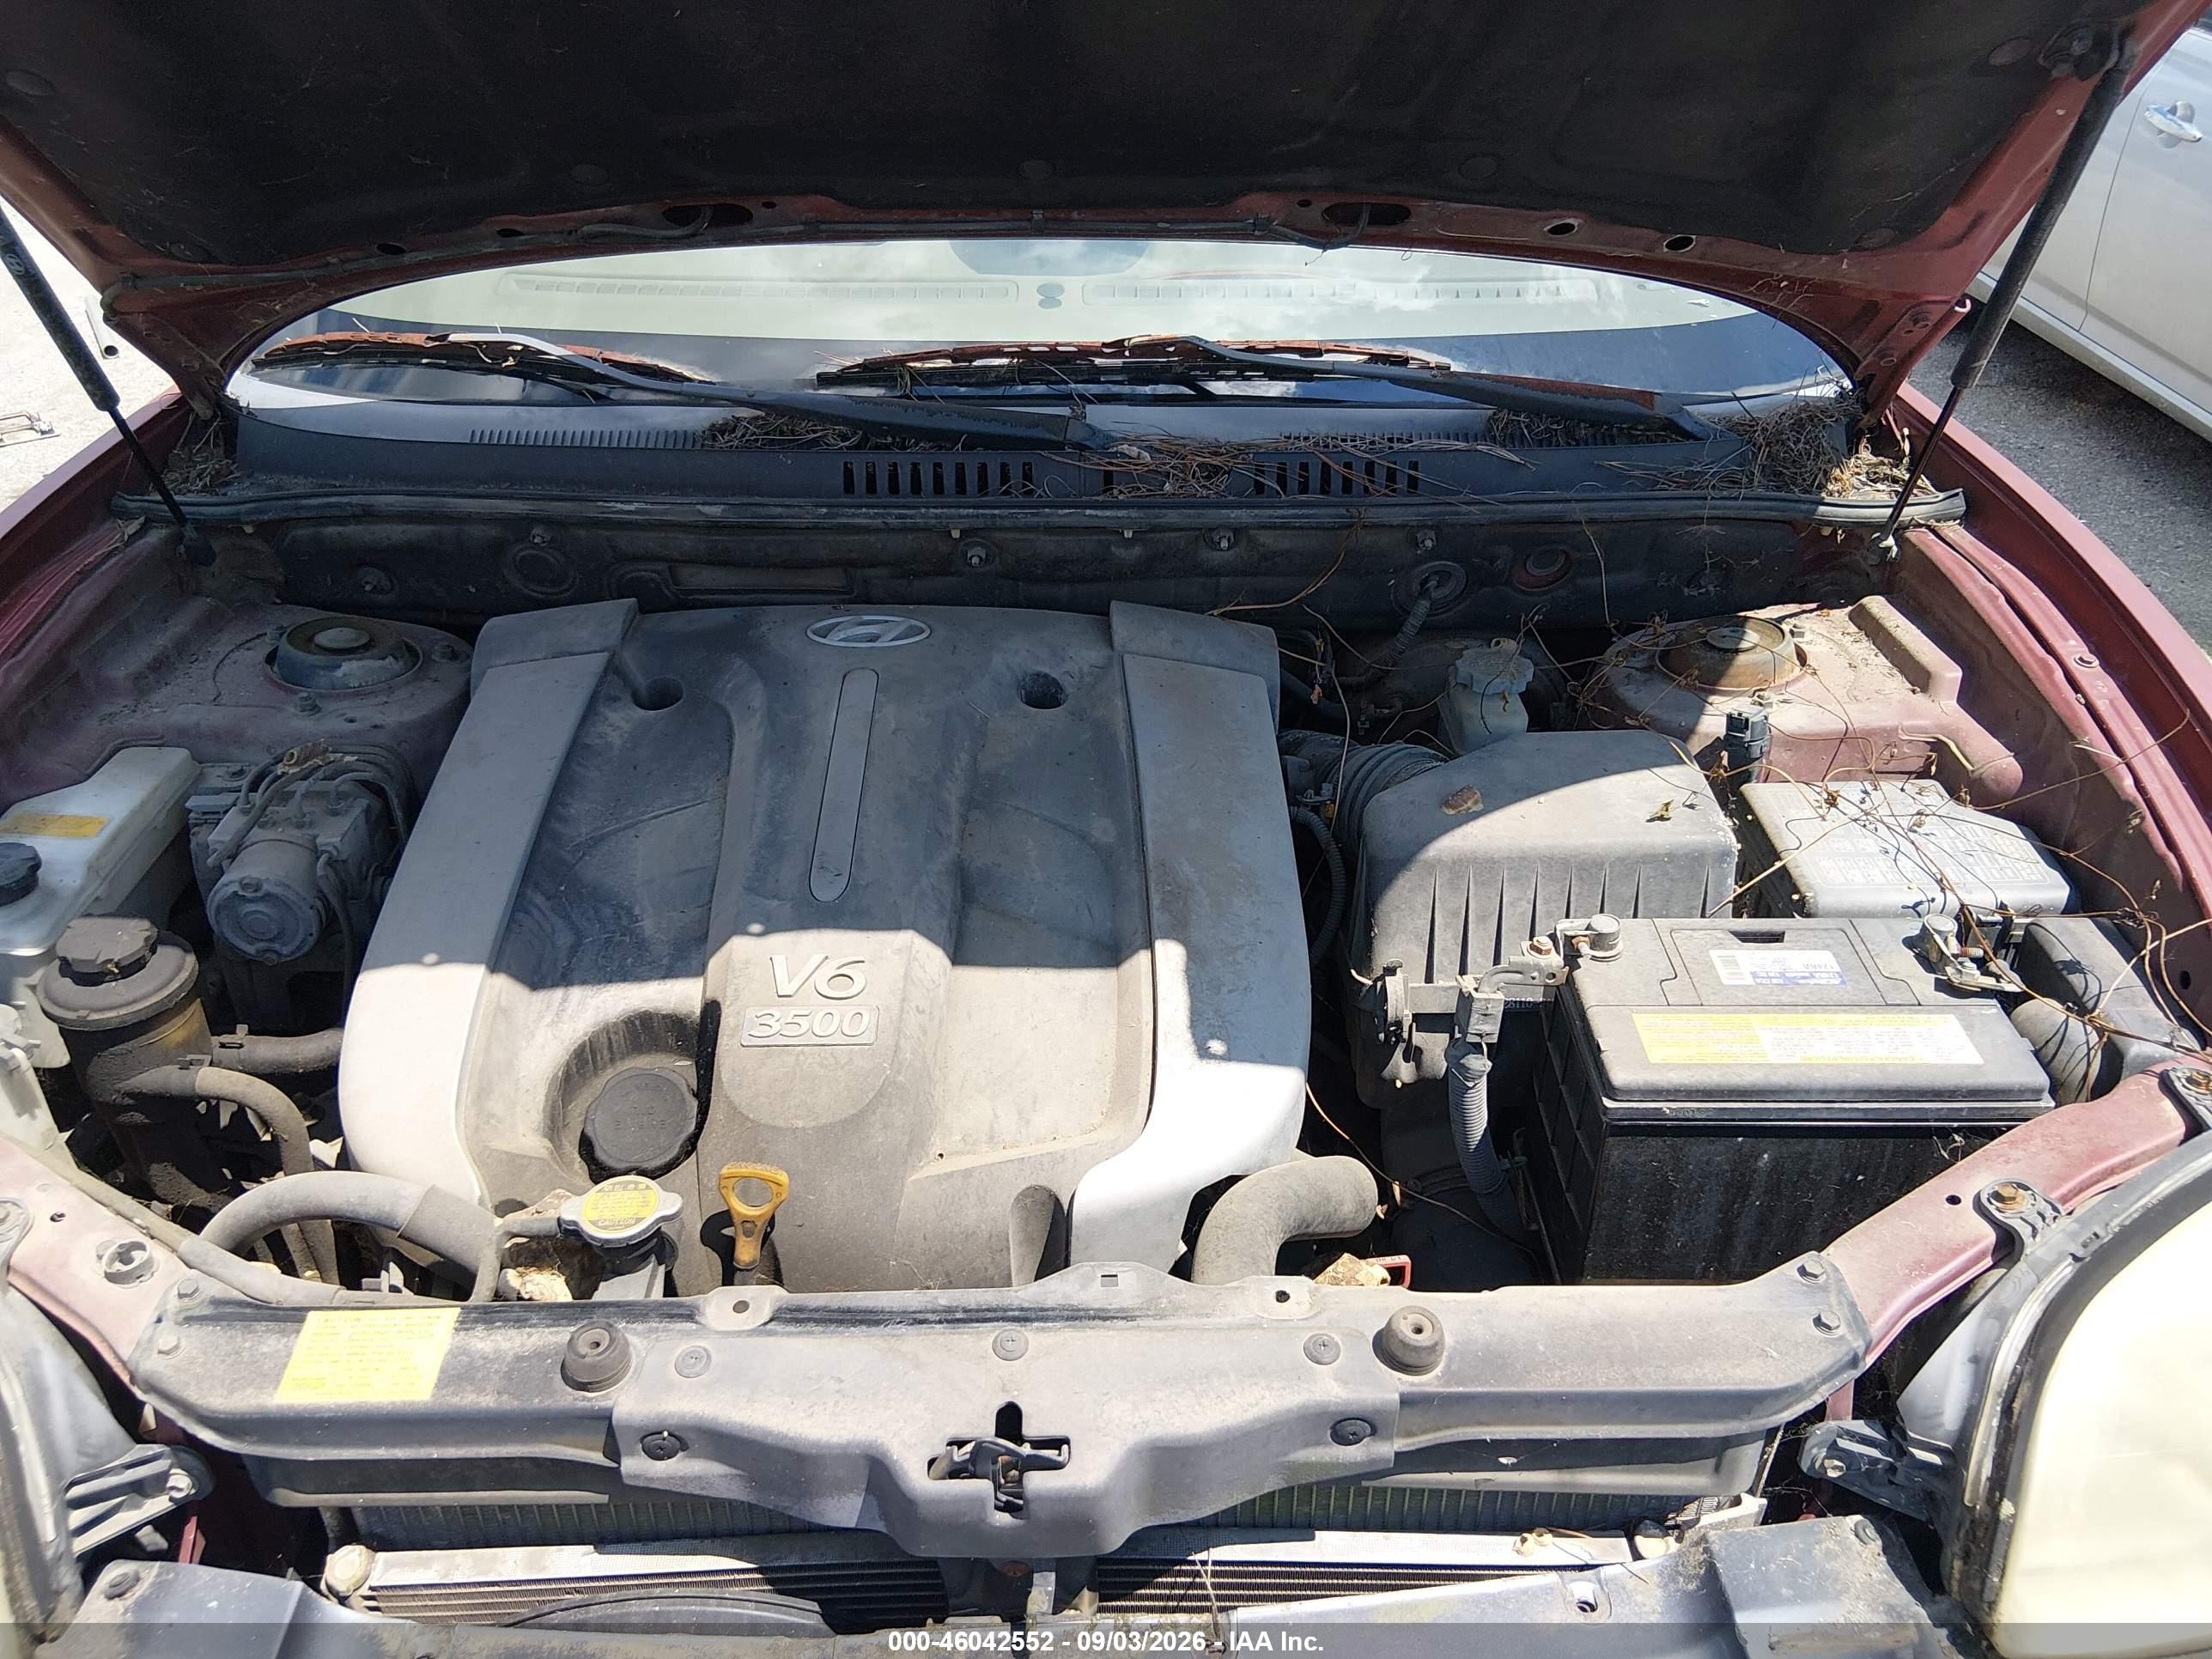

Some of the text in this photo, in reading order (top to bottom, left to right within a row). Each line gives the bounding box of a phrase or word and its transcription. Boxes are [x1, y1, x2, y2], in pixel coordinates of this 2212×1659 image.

[769, 953, 867, 1000] V6
[748, 1008, 871, 1038] 3500
[598, 1216, 636, 1227] CAUTION
